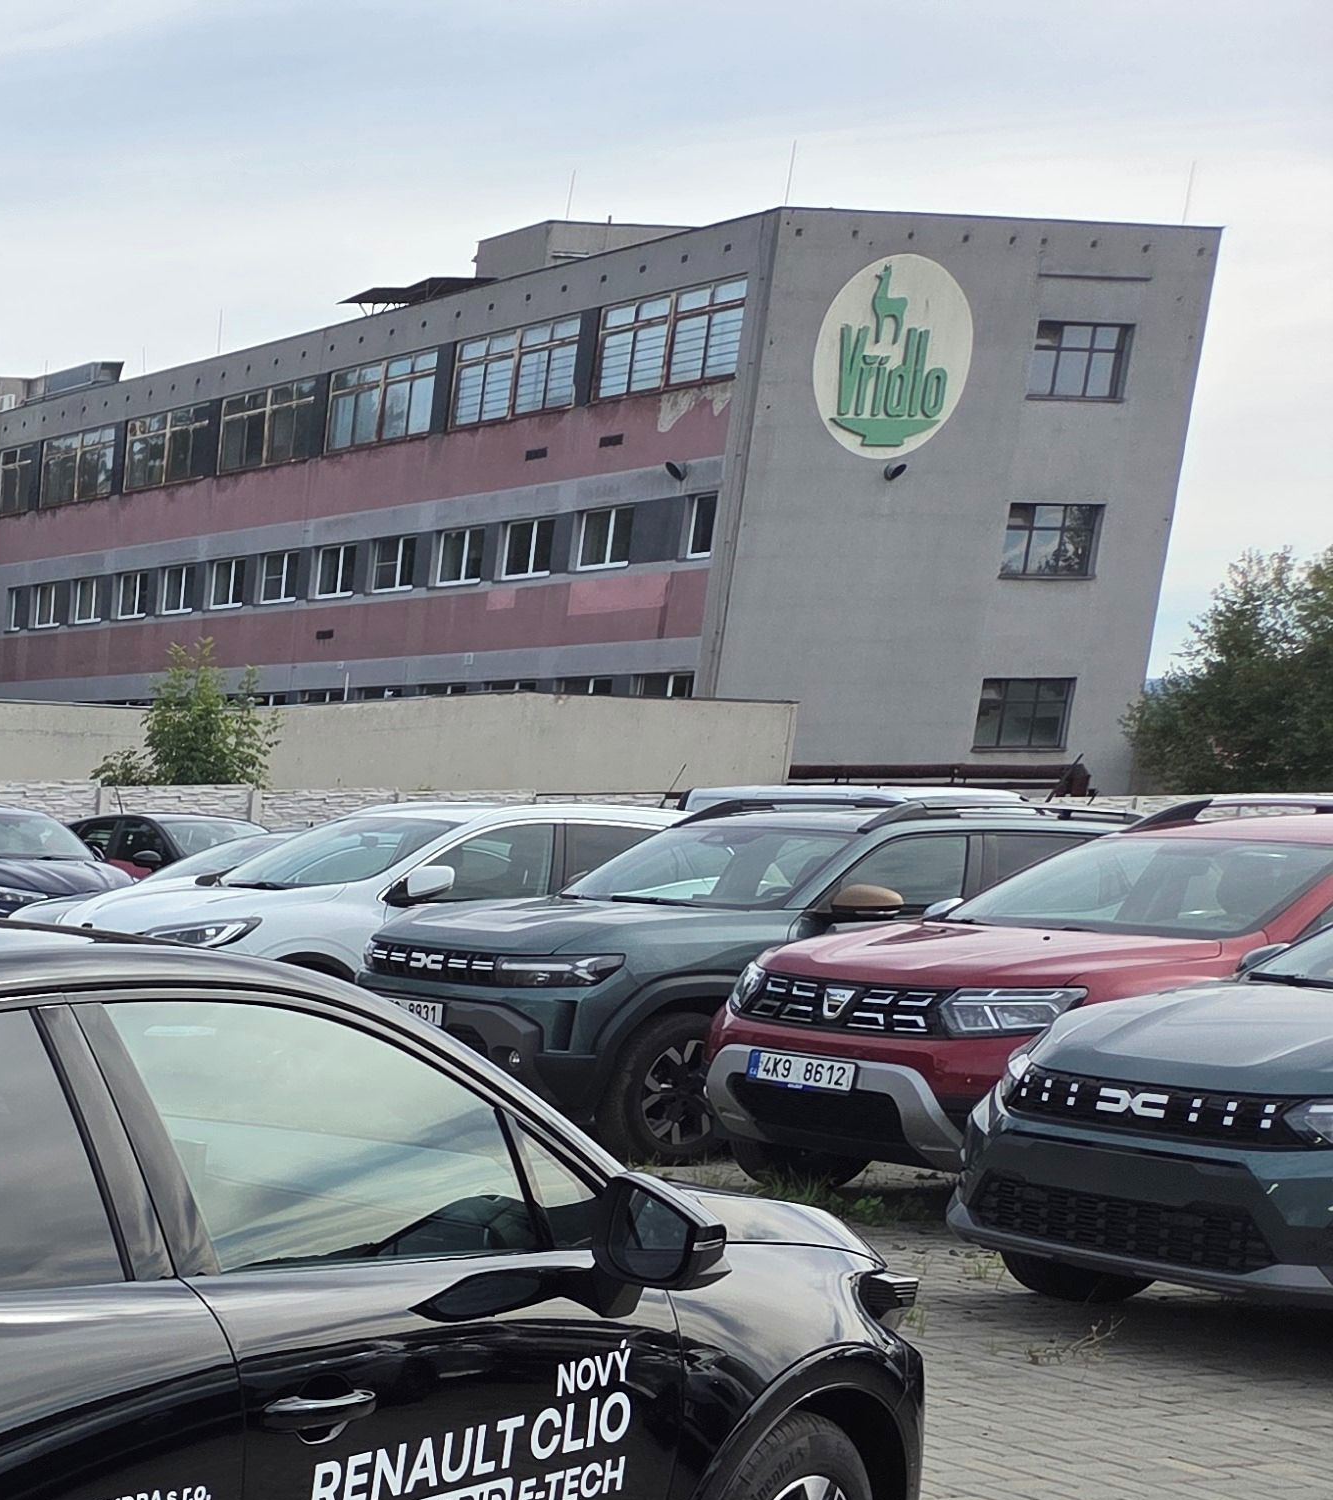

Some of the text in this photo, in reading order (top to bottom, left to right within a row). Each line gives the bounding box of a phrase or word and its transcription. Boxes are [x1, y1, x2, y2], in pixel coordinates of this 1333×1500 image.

[762, 1056, 846, 1087] 4K9 8612
[556, 1338, 631, 1397] NOVÝ
[530, 1391, 631, 1460] CLIO
